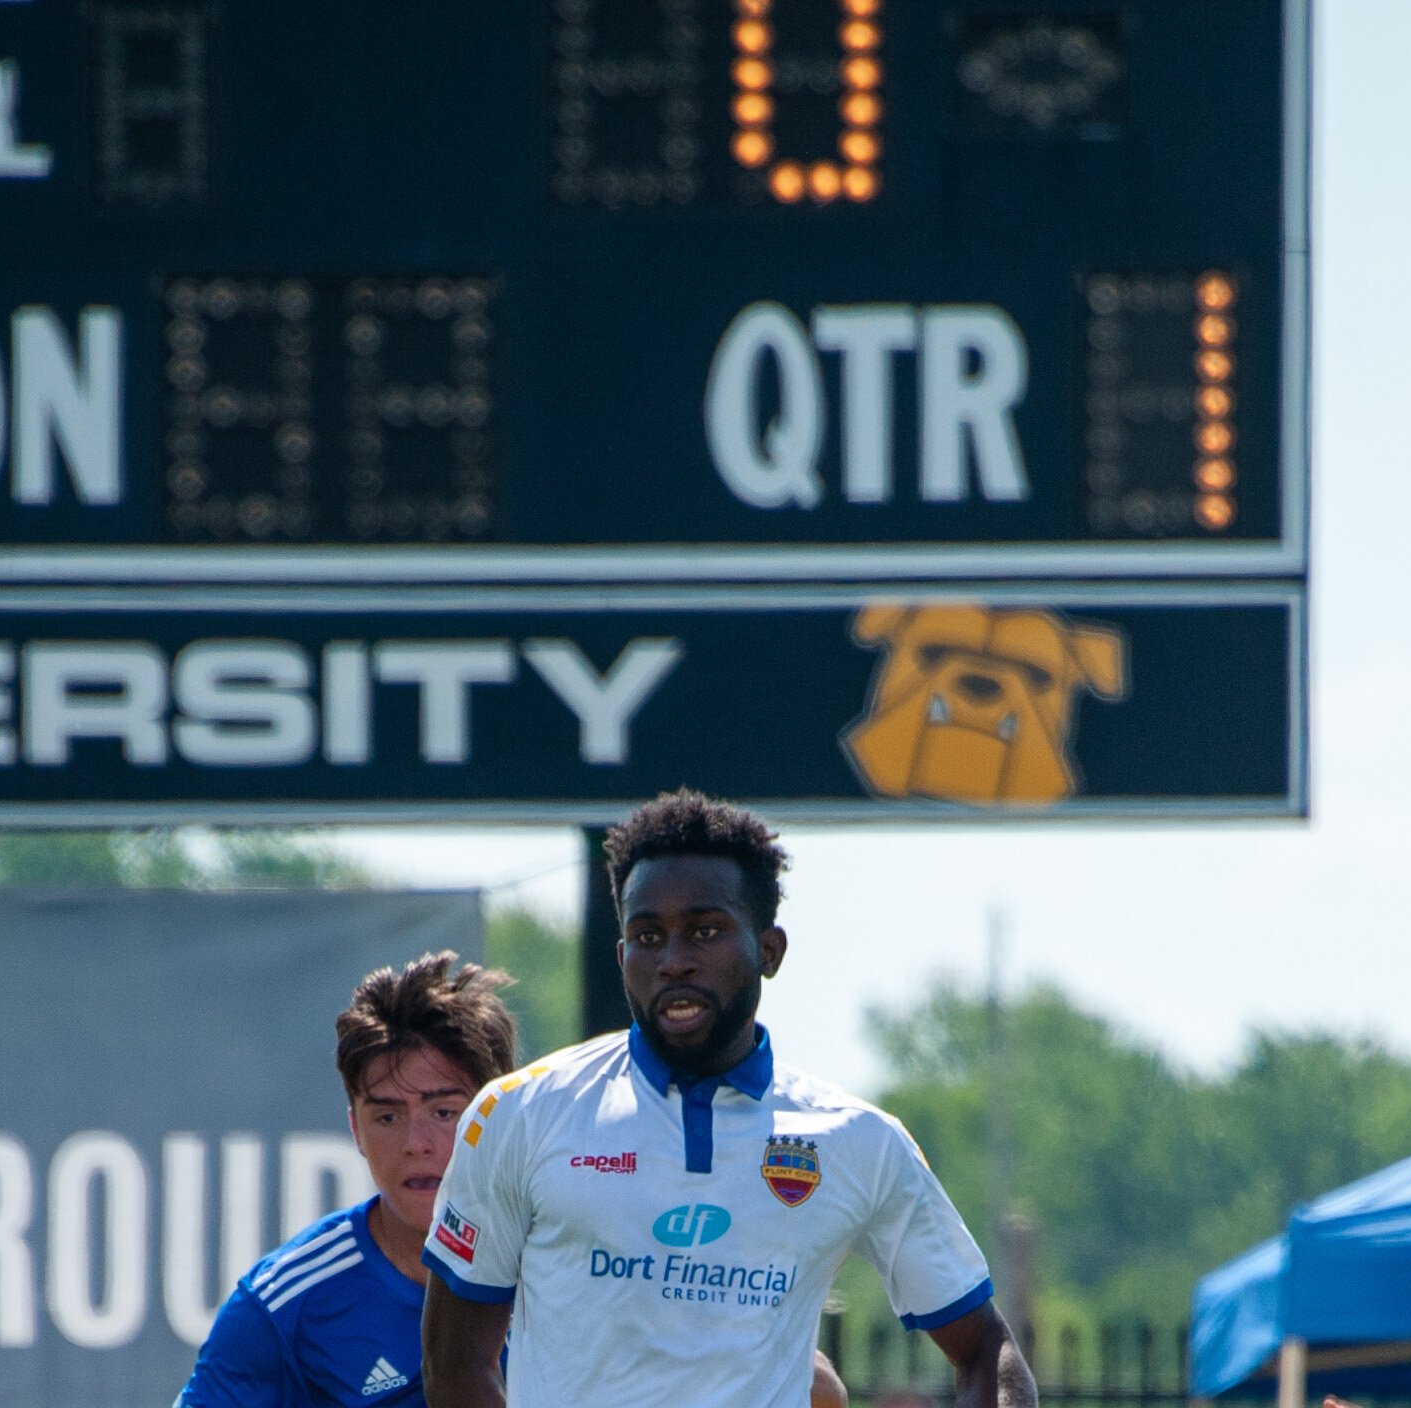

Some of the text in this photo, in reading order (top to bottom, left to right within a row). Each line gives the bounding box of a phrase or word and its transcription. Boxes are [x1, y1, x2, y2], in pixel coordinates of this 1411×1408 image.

[706, 304, 1028, 508] QTR
[1195, 275, 1235, 529] 1
[570, 1151, 637, 1171] capelli
[590, 1249, 797, 1293] Dort Financial
[661, 1286, 727, 1303] CREDIT
[361, 1375, 409, 1396] adidas
